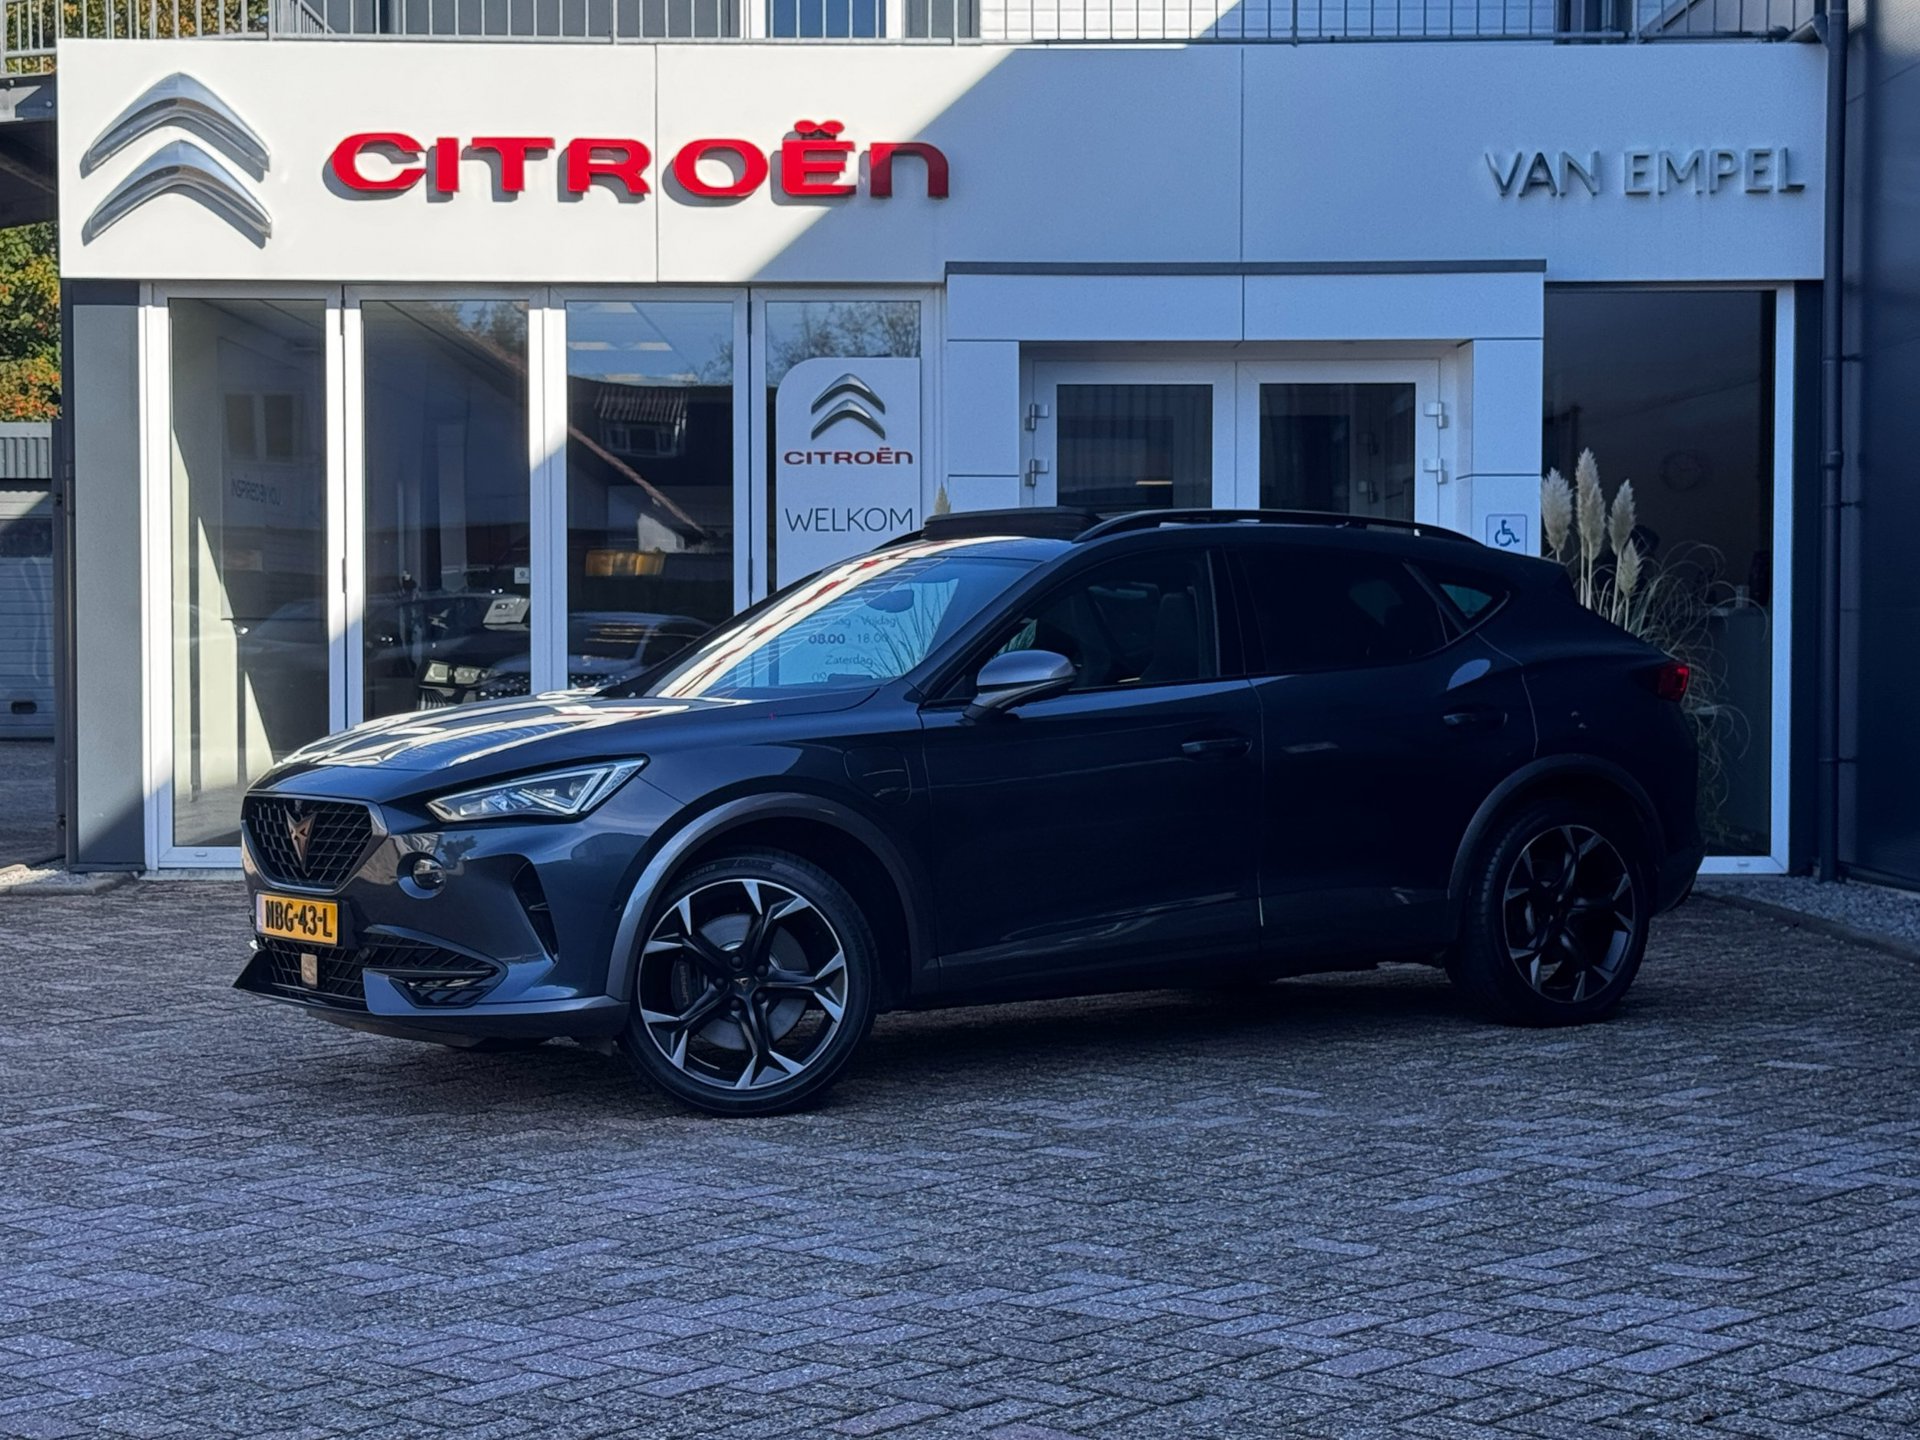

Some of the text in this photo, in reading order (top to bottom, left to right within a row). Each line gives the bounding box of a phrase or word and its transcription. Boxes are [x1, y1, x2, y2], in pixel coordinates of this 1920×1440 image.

[1484, 147, 1806, 198] VAN EMPEL
[784, 507, 914, 533] WELKOM
[825, 652, 874, 668] Zaterdag
[264, 899, 333, 938] NBG-43-L
